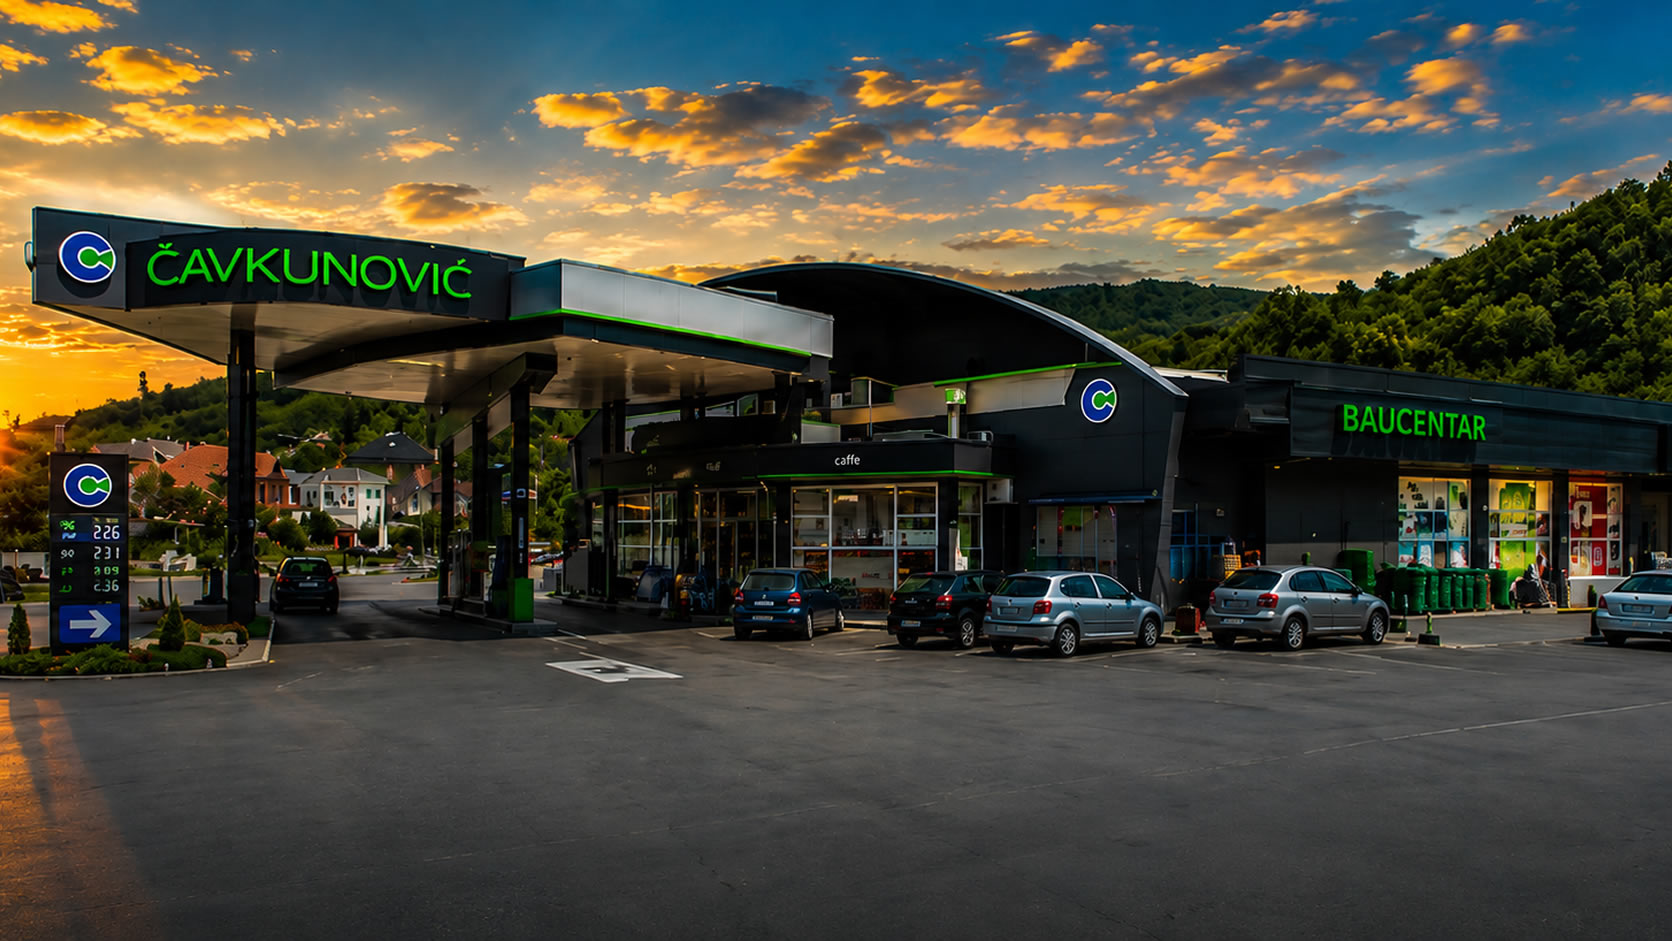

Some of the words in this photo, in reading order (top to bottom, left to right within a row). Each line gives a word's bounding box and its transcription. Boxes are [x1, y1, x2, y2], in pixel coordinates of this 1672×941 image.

[148, 242, 472, 299] ČAVKUNOVIĆ
[1343, 403, 1487, 441] BAUCENTAR
[834, 453, 861, 466] caffe
[94, 524, 120, 540] 226
[94, 546, 120, 560] 231
